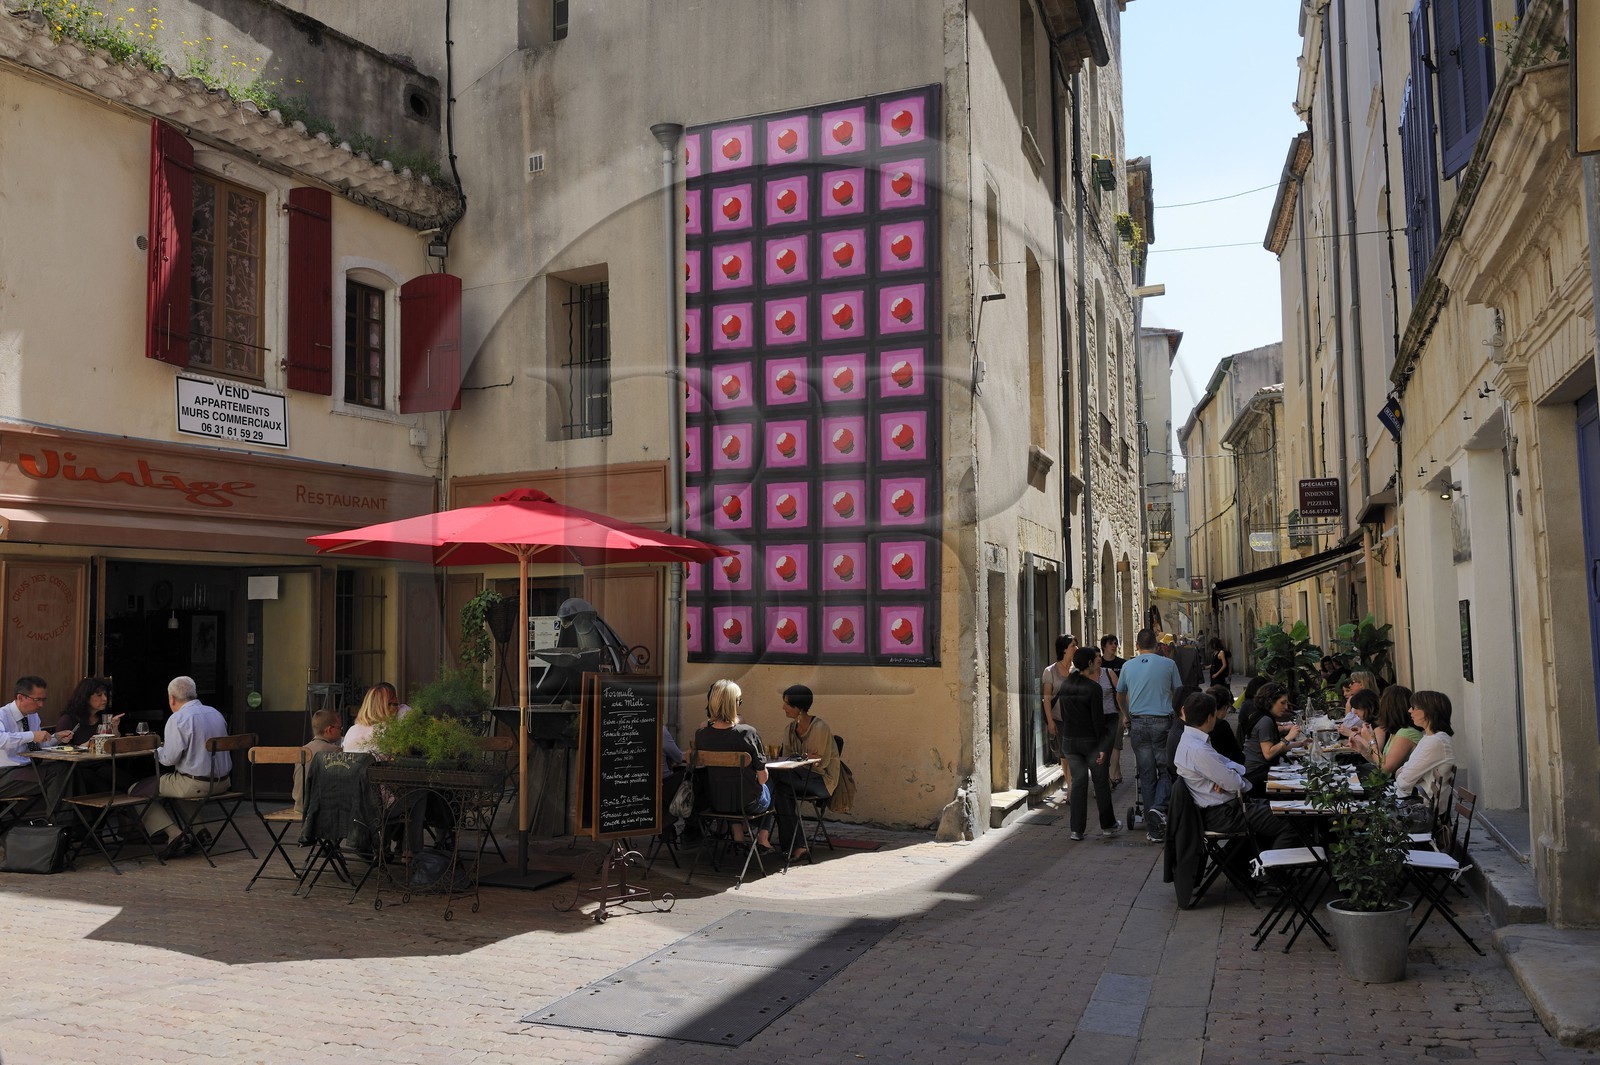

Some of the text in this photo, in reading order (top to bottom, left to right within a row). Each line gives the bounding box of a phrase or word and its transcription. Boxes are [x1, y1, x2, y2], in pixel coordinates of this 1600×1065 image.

[216, 384, 250, 400] VEND
[194, 396, 270, 417] APPARTEMENTS
[181, 406, 282, 431] MURS COMMERCIAUX
[201, 422, 264, 441] 06 31 61 59 29
[18, 449, 258, 508] Vintage
[12, 580, 31, 602] CRUS
[31, 574, 47, 584] DES
[37, 603, 49, 611] ET
[12, 615, 72, 641] DU LANGUEDOC
[603, 686, 634, 698] Formule
[624, 698, 644, 707] Midi
